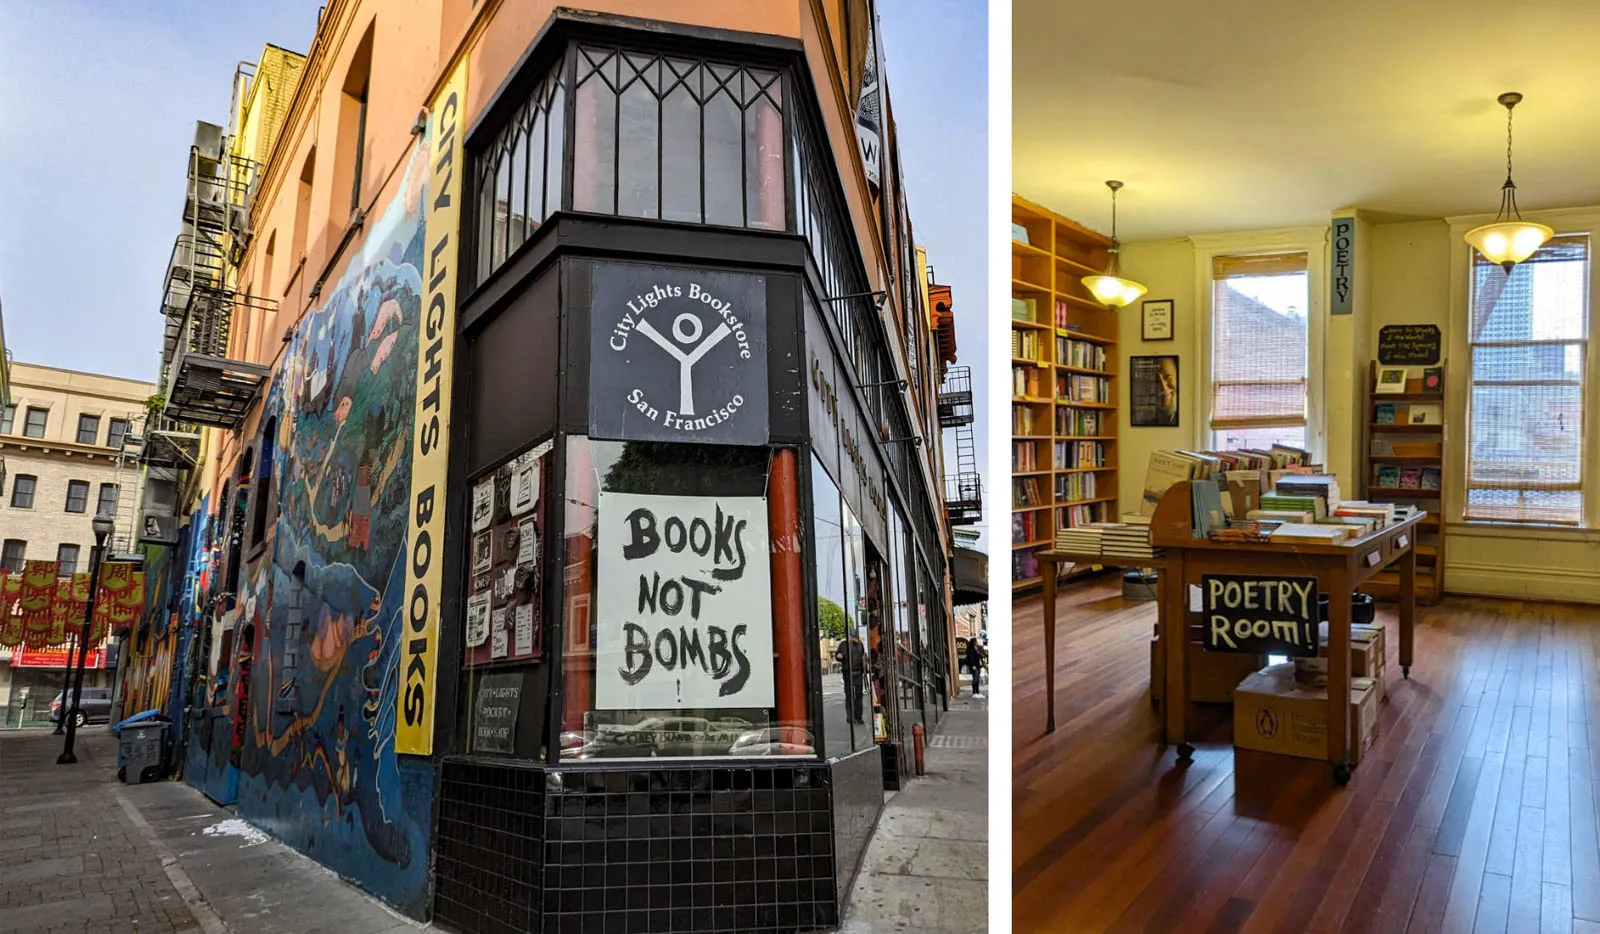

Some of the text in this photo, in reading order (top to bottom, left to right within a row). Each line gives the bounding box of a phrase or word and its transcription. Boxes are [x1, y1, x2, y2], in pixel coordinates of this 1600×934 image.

[1335, 223, 1350, 303] POETRY
[610, 283, 751, 360] City Lights Bookstore
[404, 91, 458, 729] CITY LIGHTS BOOKS
[627, 388, 744, 431] San Francisco
[622, 501, 747, 581] BOOKS
[638, 571, 722, 620] NOT
[1208, 578, 1314, 619] POETRY
[618, 621, 751, 697] BOMBS
